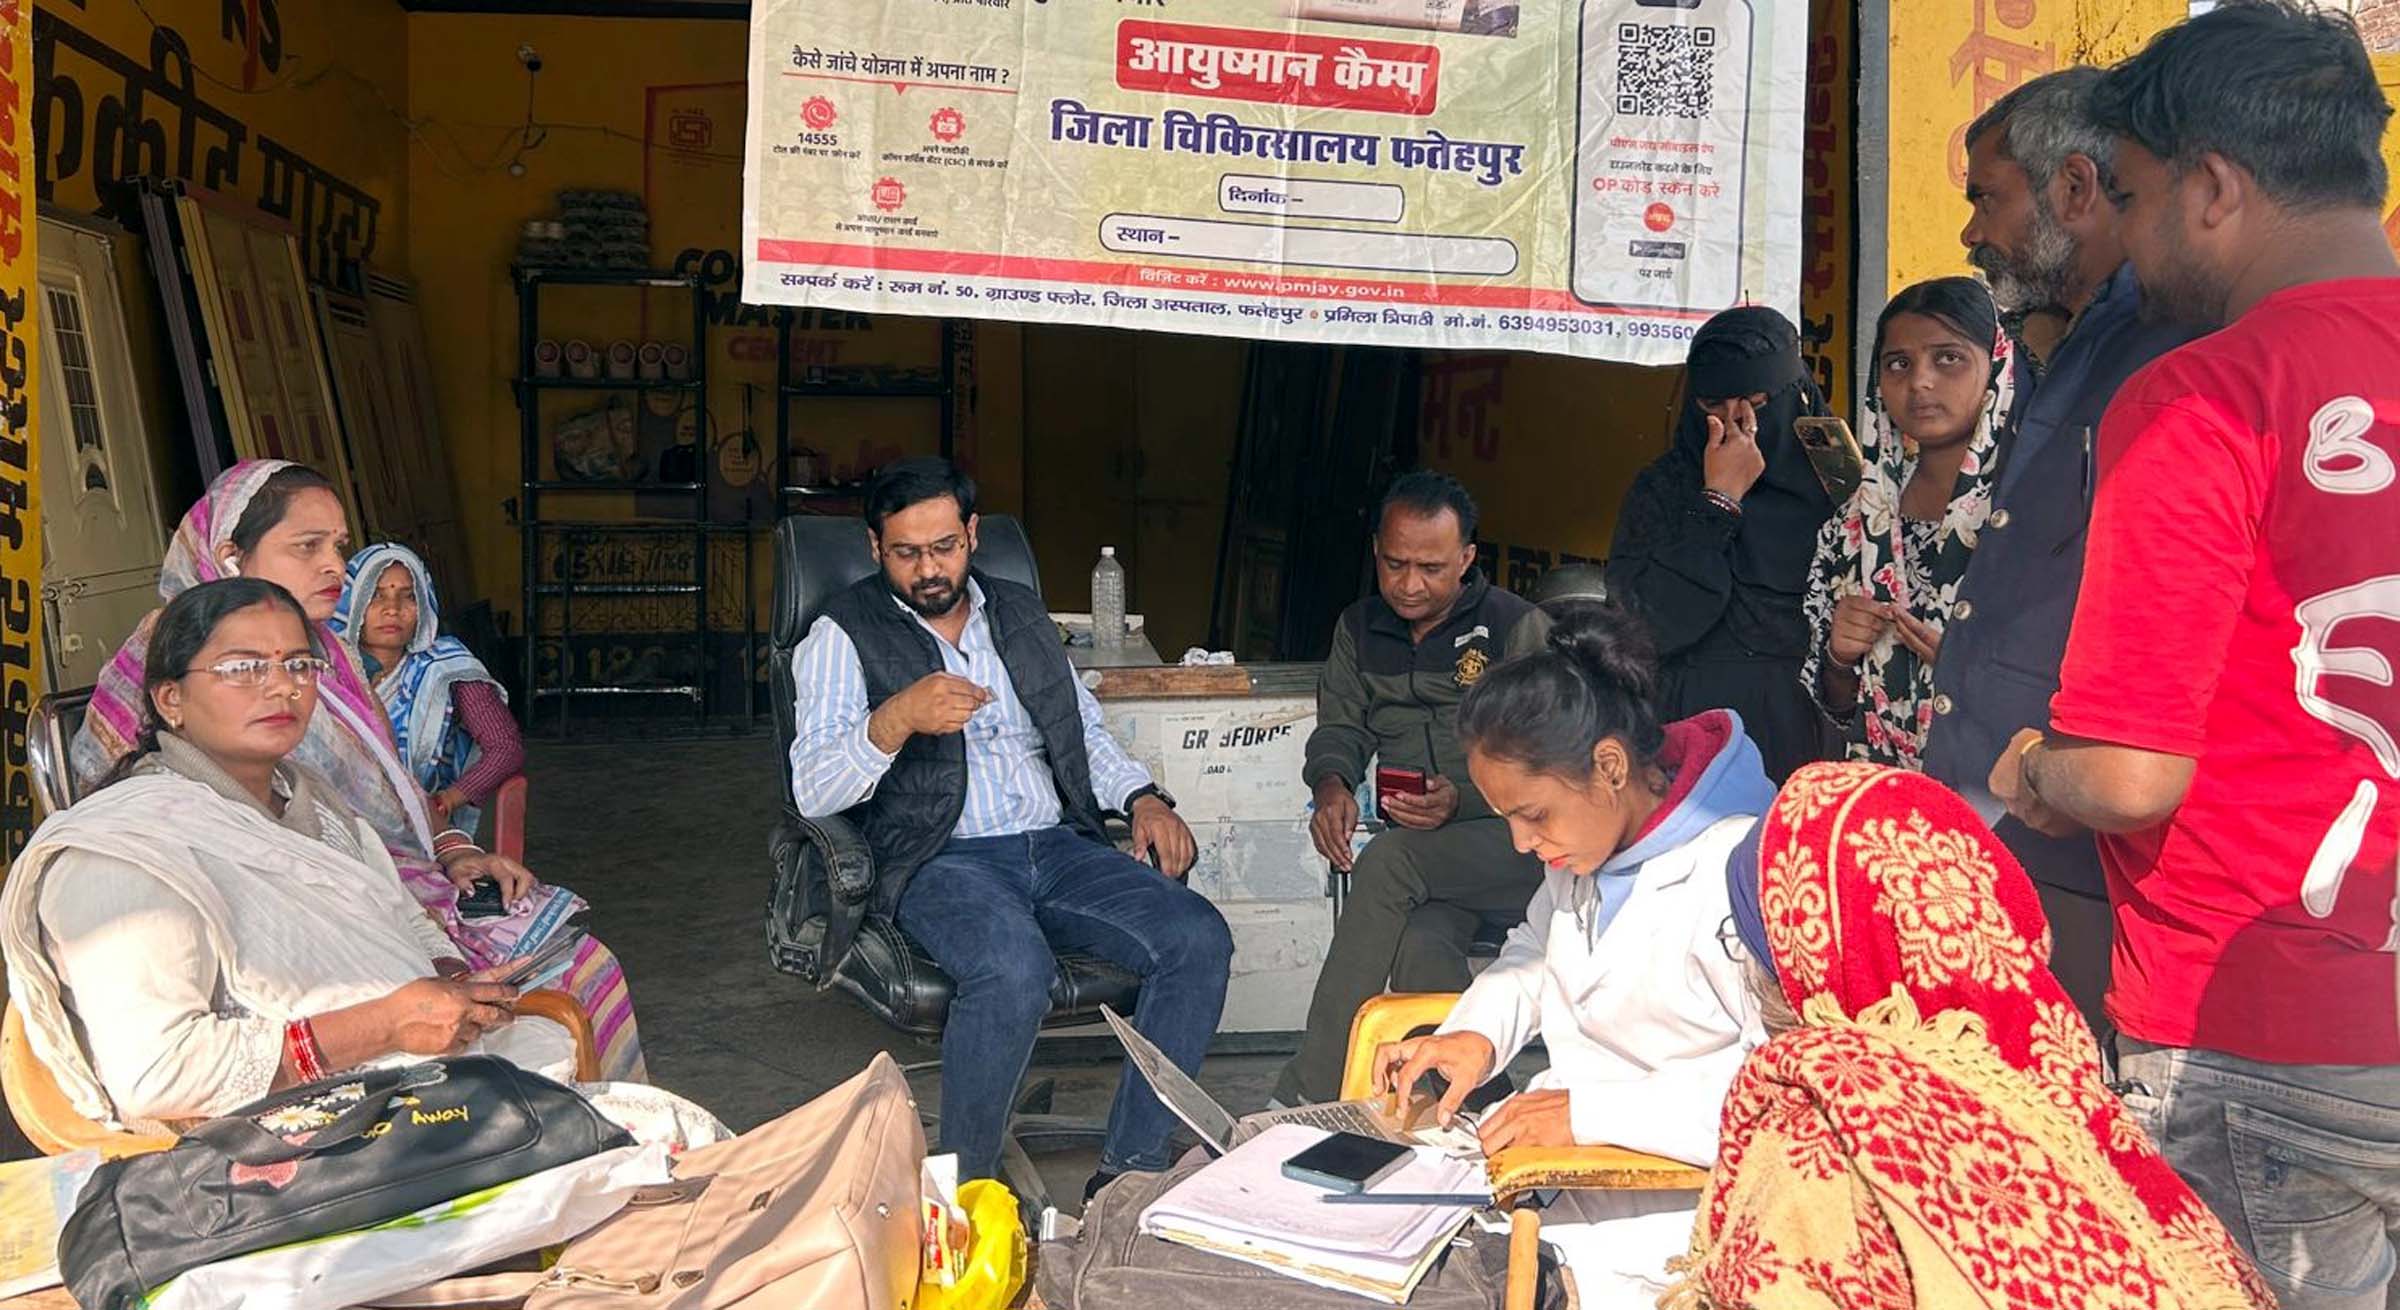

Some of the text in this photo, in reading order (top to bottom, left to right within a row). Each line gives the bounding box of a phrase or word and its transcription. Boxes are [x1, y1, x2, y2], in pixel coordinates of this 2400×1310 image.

[792, 43, 1010, 84] कैसे जांचे योजना में अपना नाम ?
[1128, 35, 1429, 97] आयुष्मान कैम्प
[797, 132, 838, 146] 14555
[1051, 99, 1525, 185] जिला चिकित्सालय फतेहपुर
[1115, 226, 1164, 244] स्थान
[780, 272, 837, 288] सम्पर्क
[889, 281, 922, 295] रूम
[985, 286, 1041, 303] ग्राउण्ड
[1103, 290, 1148, 309] जिला
[1238, 301, 1304, 324] फतेहपुर
[1325, 308, 1378, 325] प्रमिला
[1383, 307, 1434, 327] त्रिपाठी
[1628, 321, 1695, 341] 993560
[1223, 278, 1406, 298] www.pmjay.gov.in
